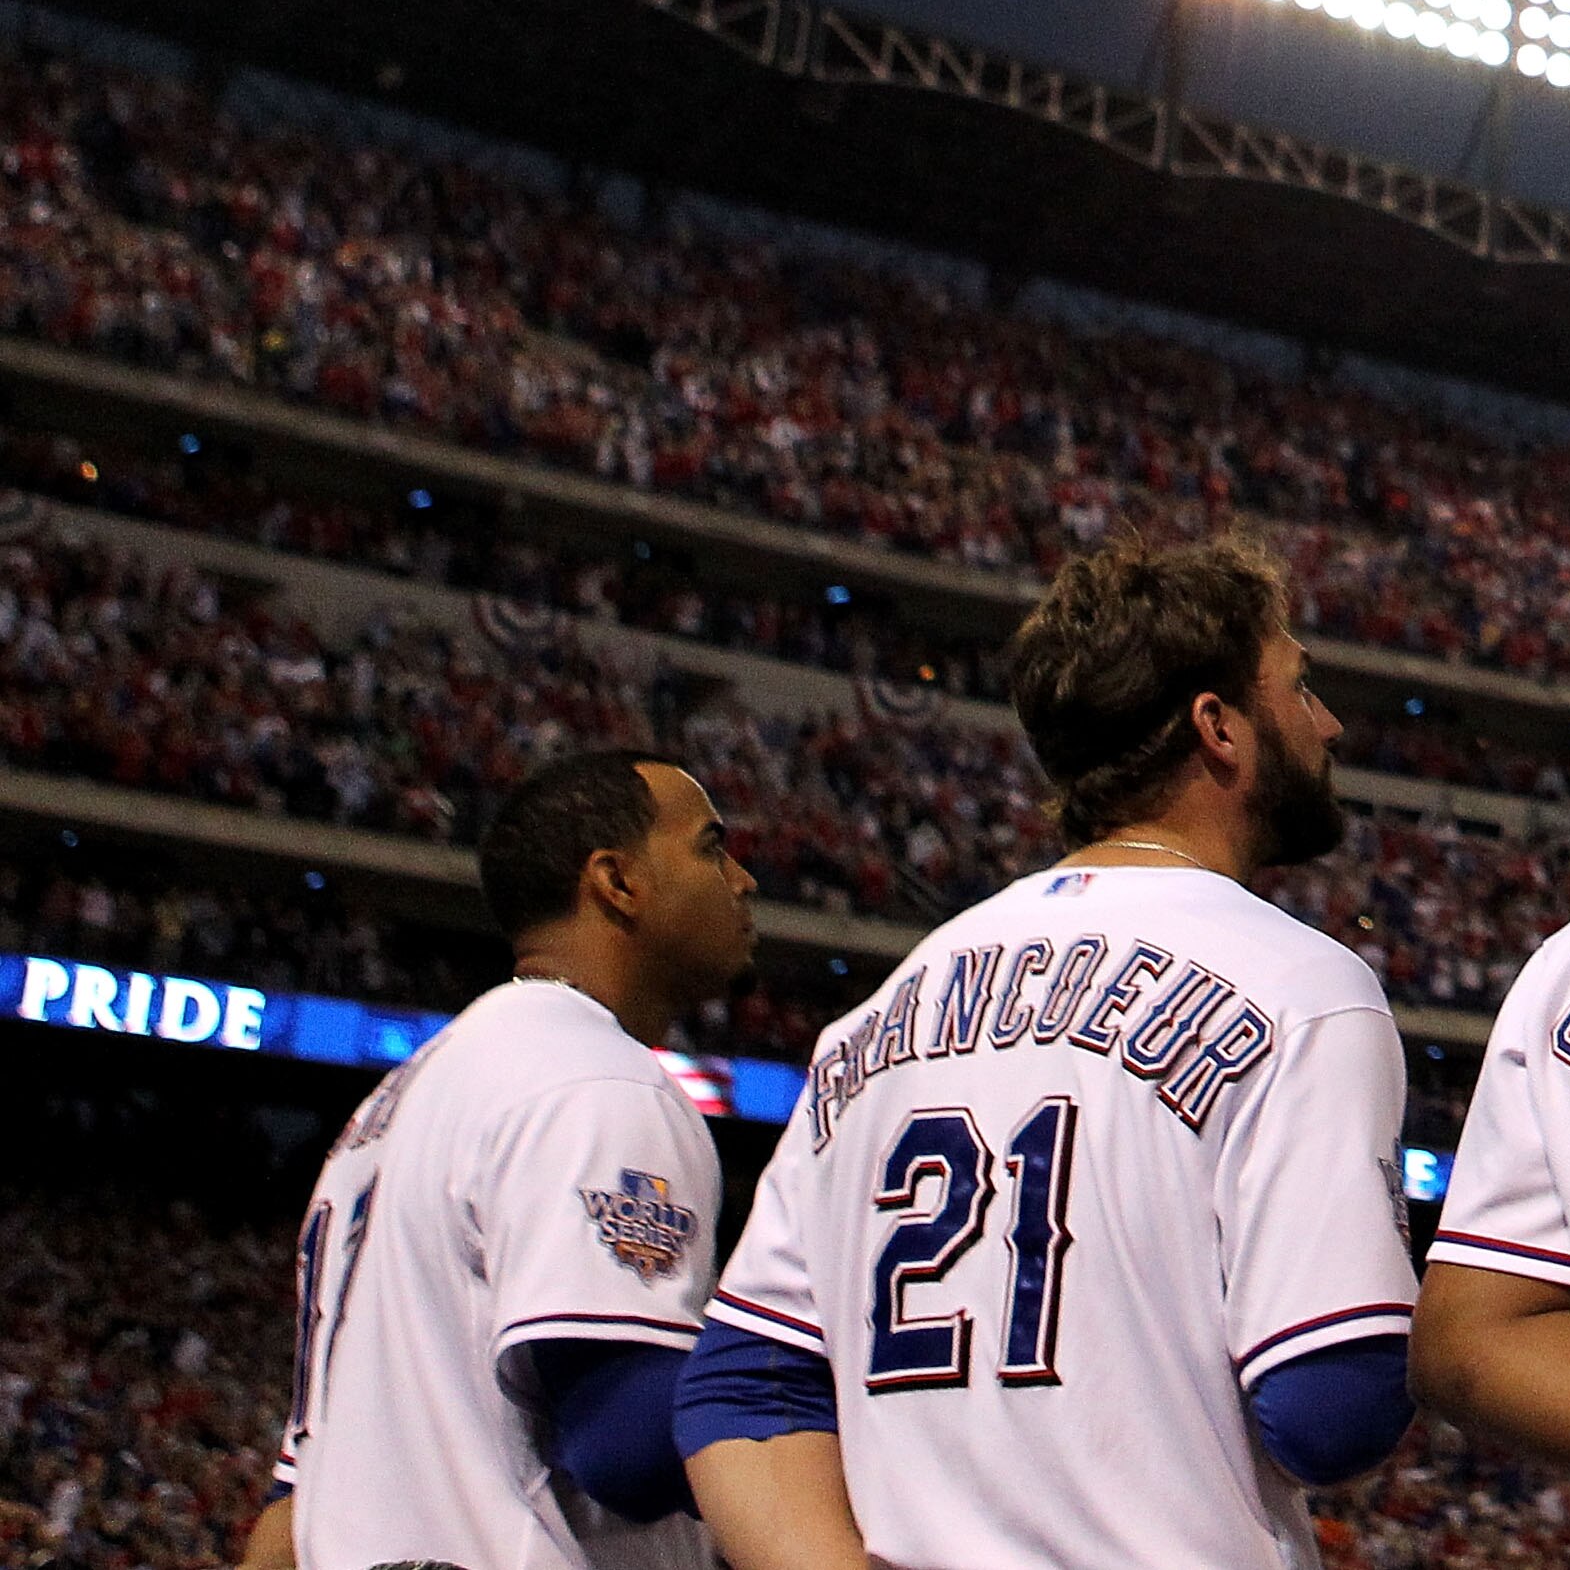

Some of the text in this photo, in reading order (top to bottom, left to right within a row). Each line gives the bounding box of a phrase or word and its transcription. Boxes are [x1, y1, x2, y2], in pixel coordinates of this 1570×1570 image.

[16, 956, 266, 1051] PRIDE
[807, 933, 1274, 1154] FRANCOEUR
[578, 1187, 698, 1238] WORLD
[600, 1216, 684, 1256] SERIES
[866, 1095, 1078, 1396] 21
